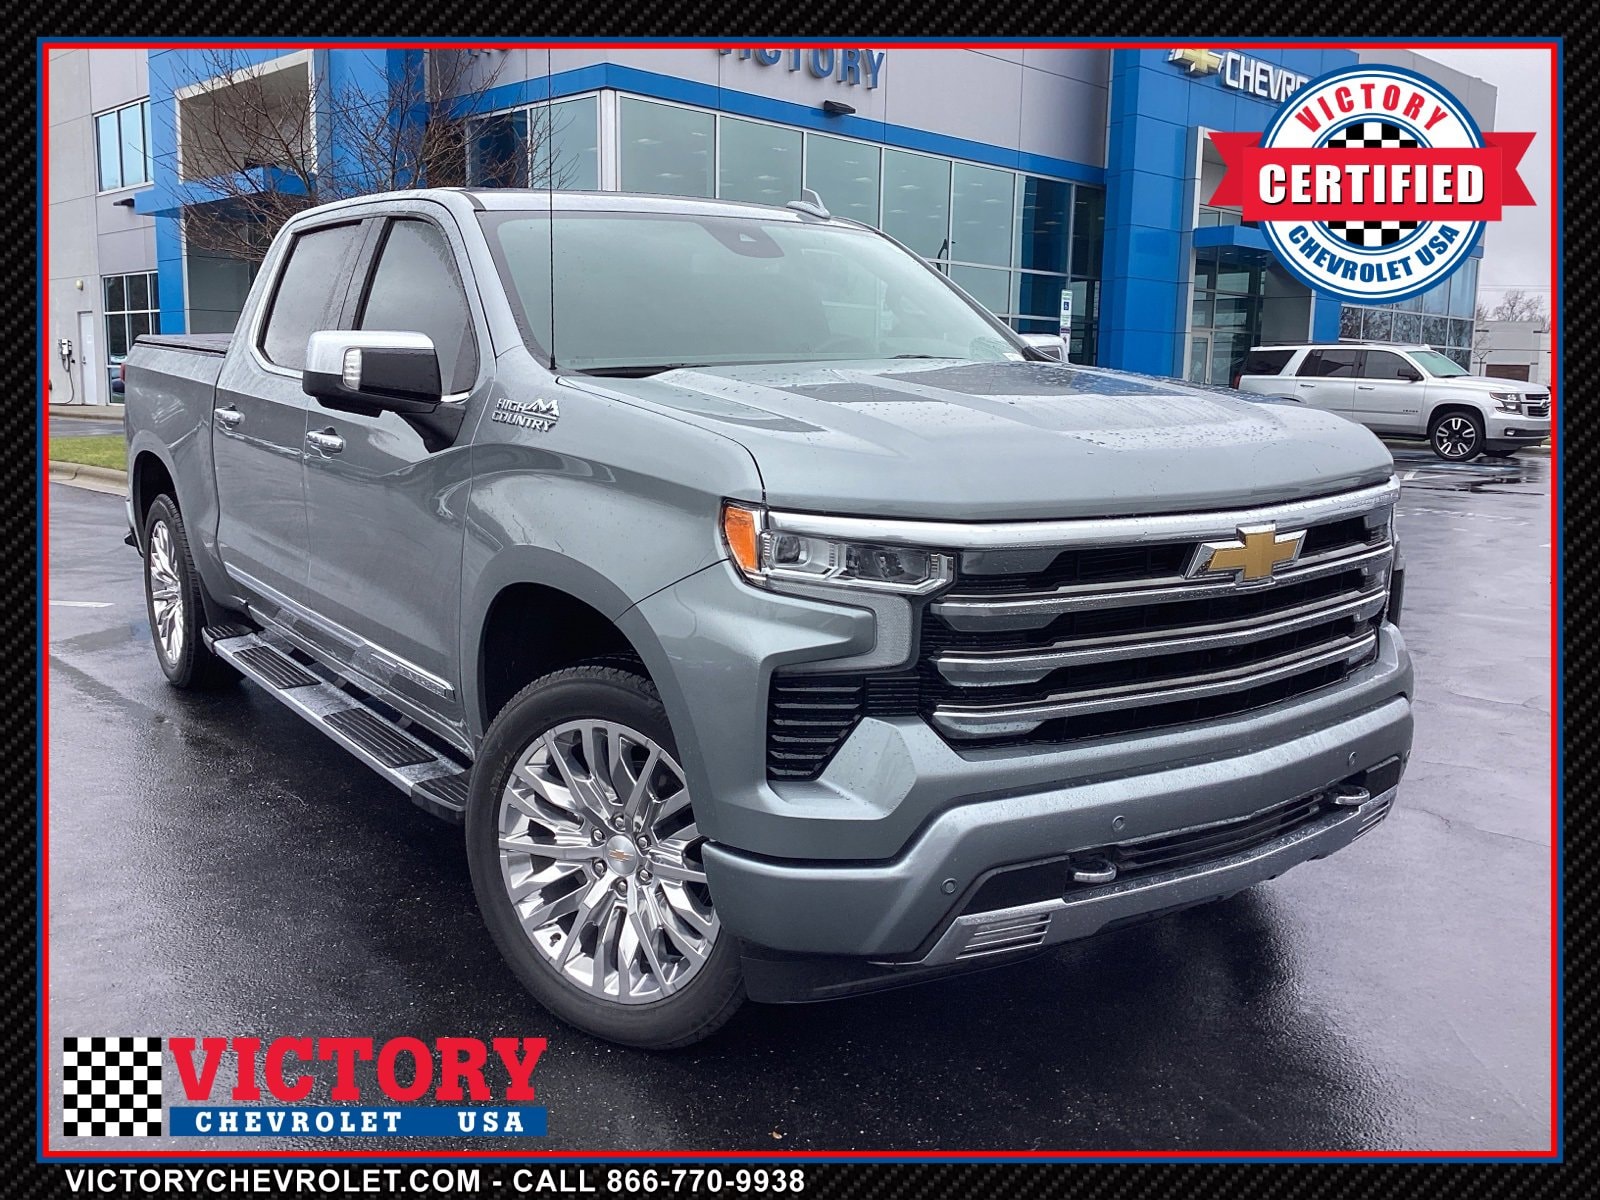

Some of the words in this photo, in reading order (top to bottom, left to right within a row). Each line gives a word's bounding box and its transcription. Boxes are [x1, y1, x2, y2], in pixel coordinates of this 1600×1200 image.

[719, 49, 884, 89] TORY
[496, 398, 528, 412] HIGH
[491, 410, 556, 432] COUNTRY
